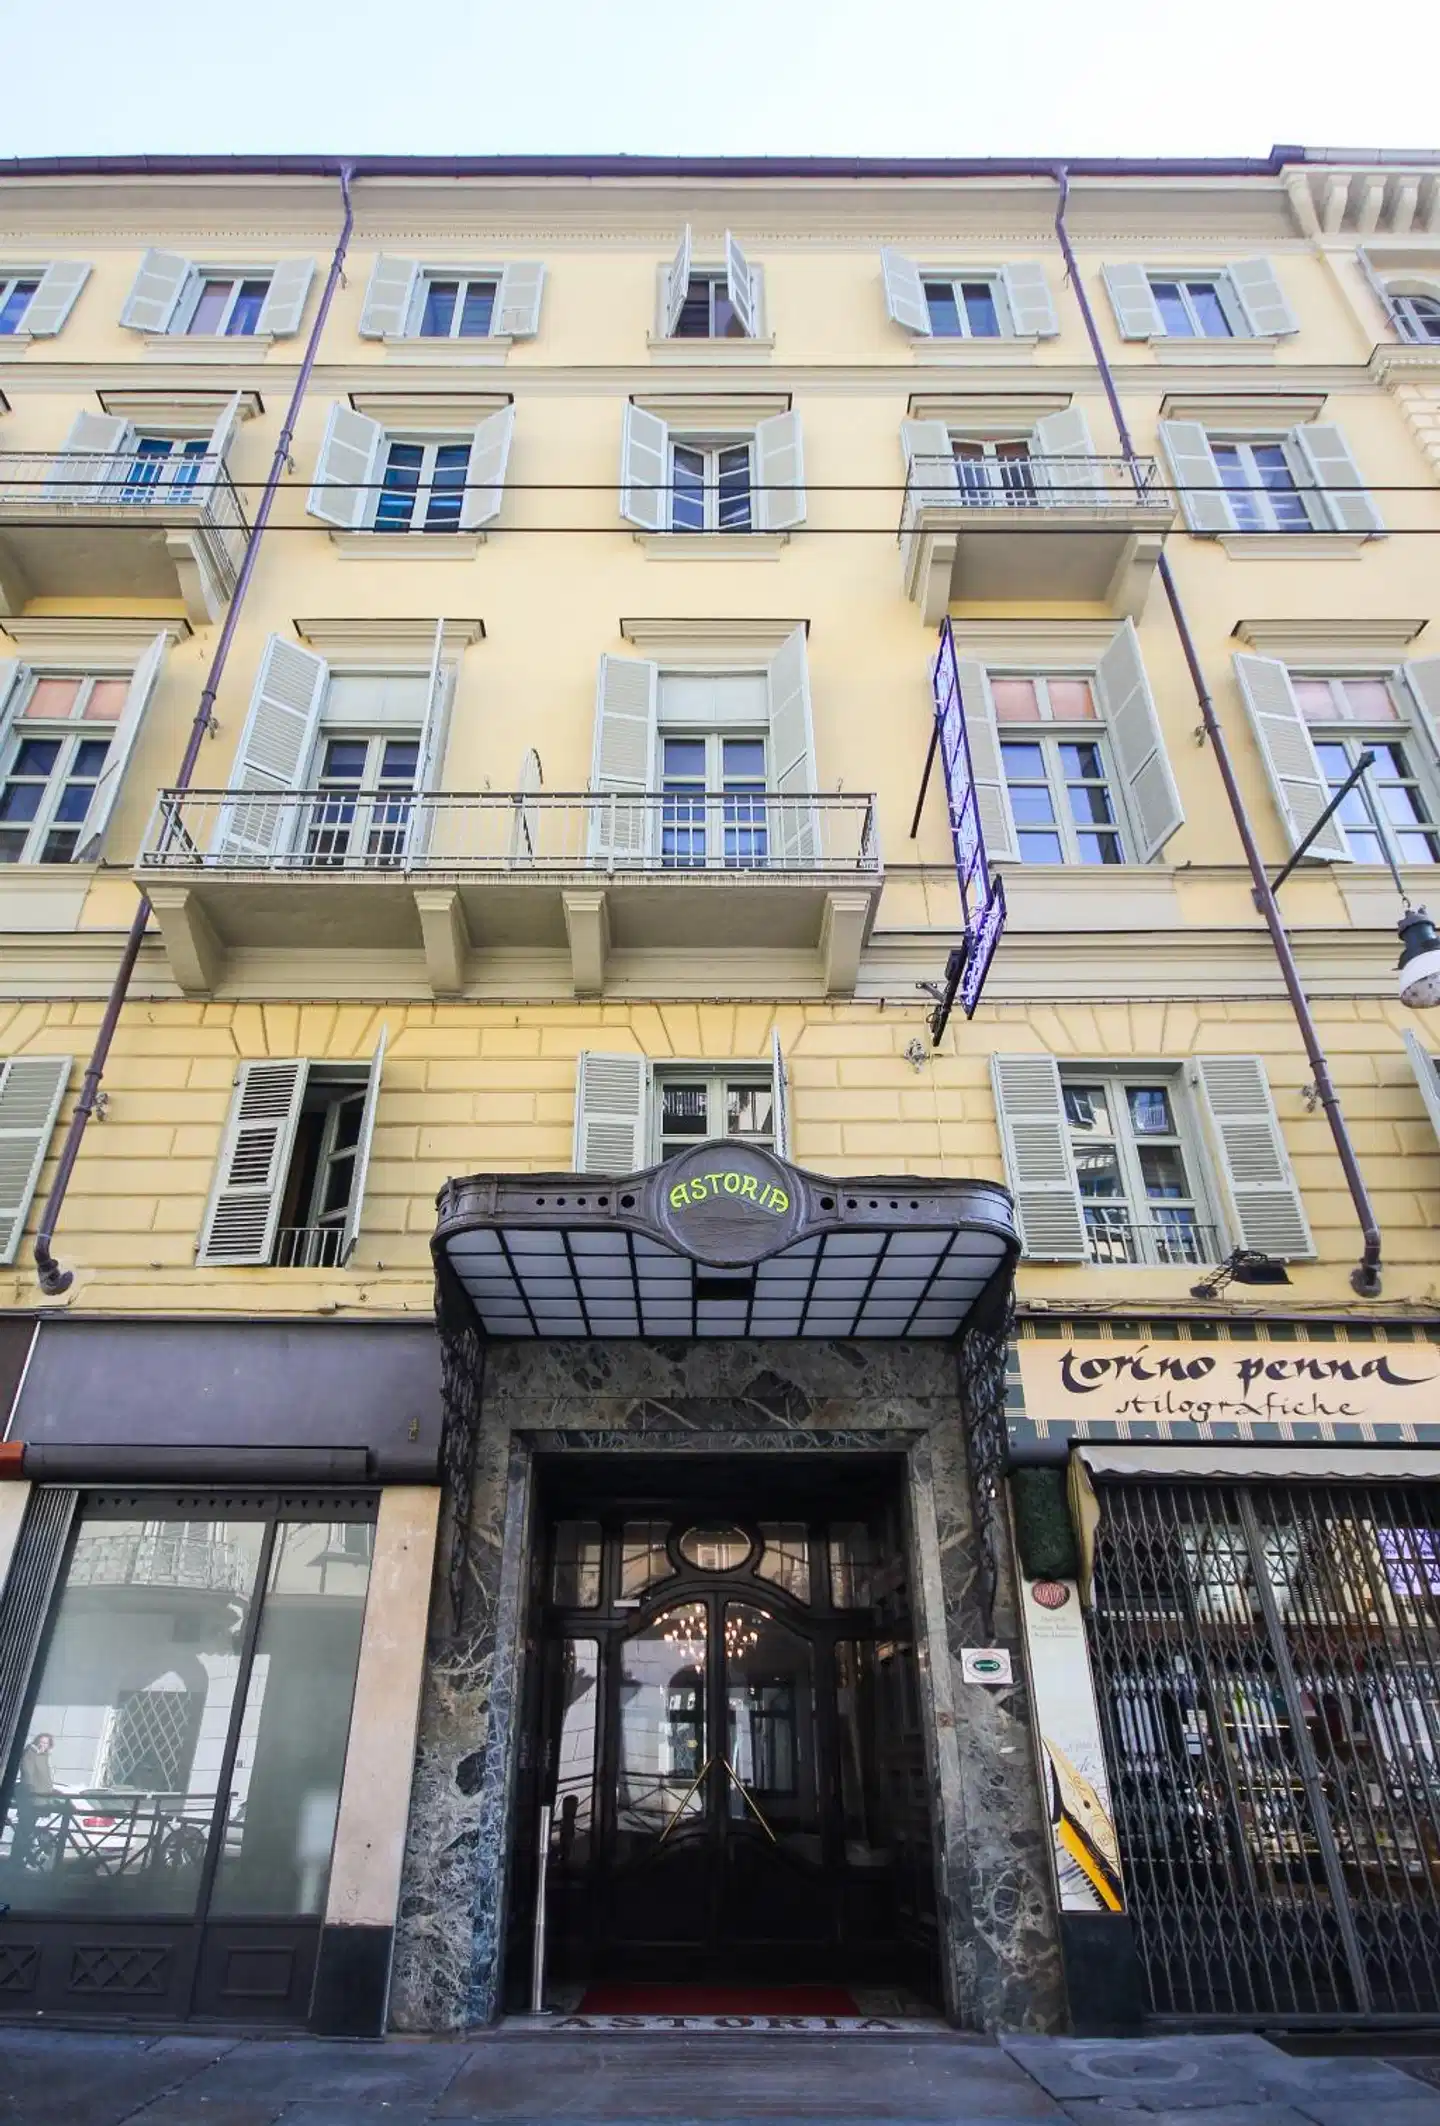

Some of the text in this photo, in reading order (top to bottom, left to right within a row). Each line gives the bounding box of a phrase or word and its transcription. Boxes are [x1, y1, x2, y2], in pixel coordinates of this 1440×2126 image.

[670, 1173, 789, 1212] ASTORIA
[1059, 1345, 1436, 1397] torino penna
[1115, 1391, 1366, 1422] stilografiche
[551, 2015, 902, 2030] ASTORIA
